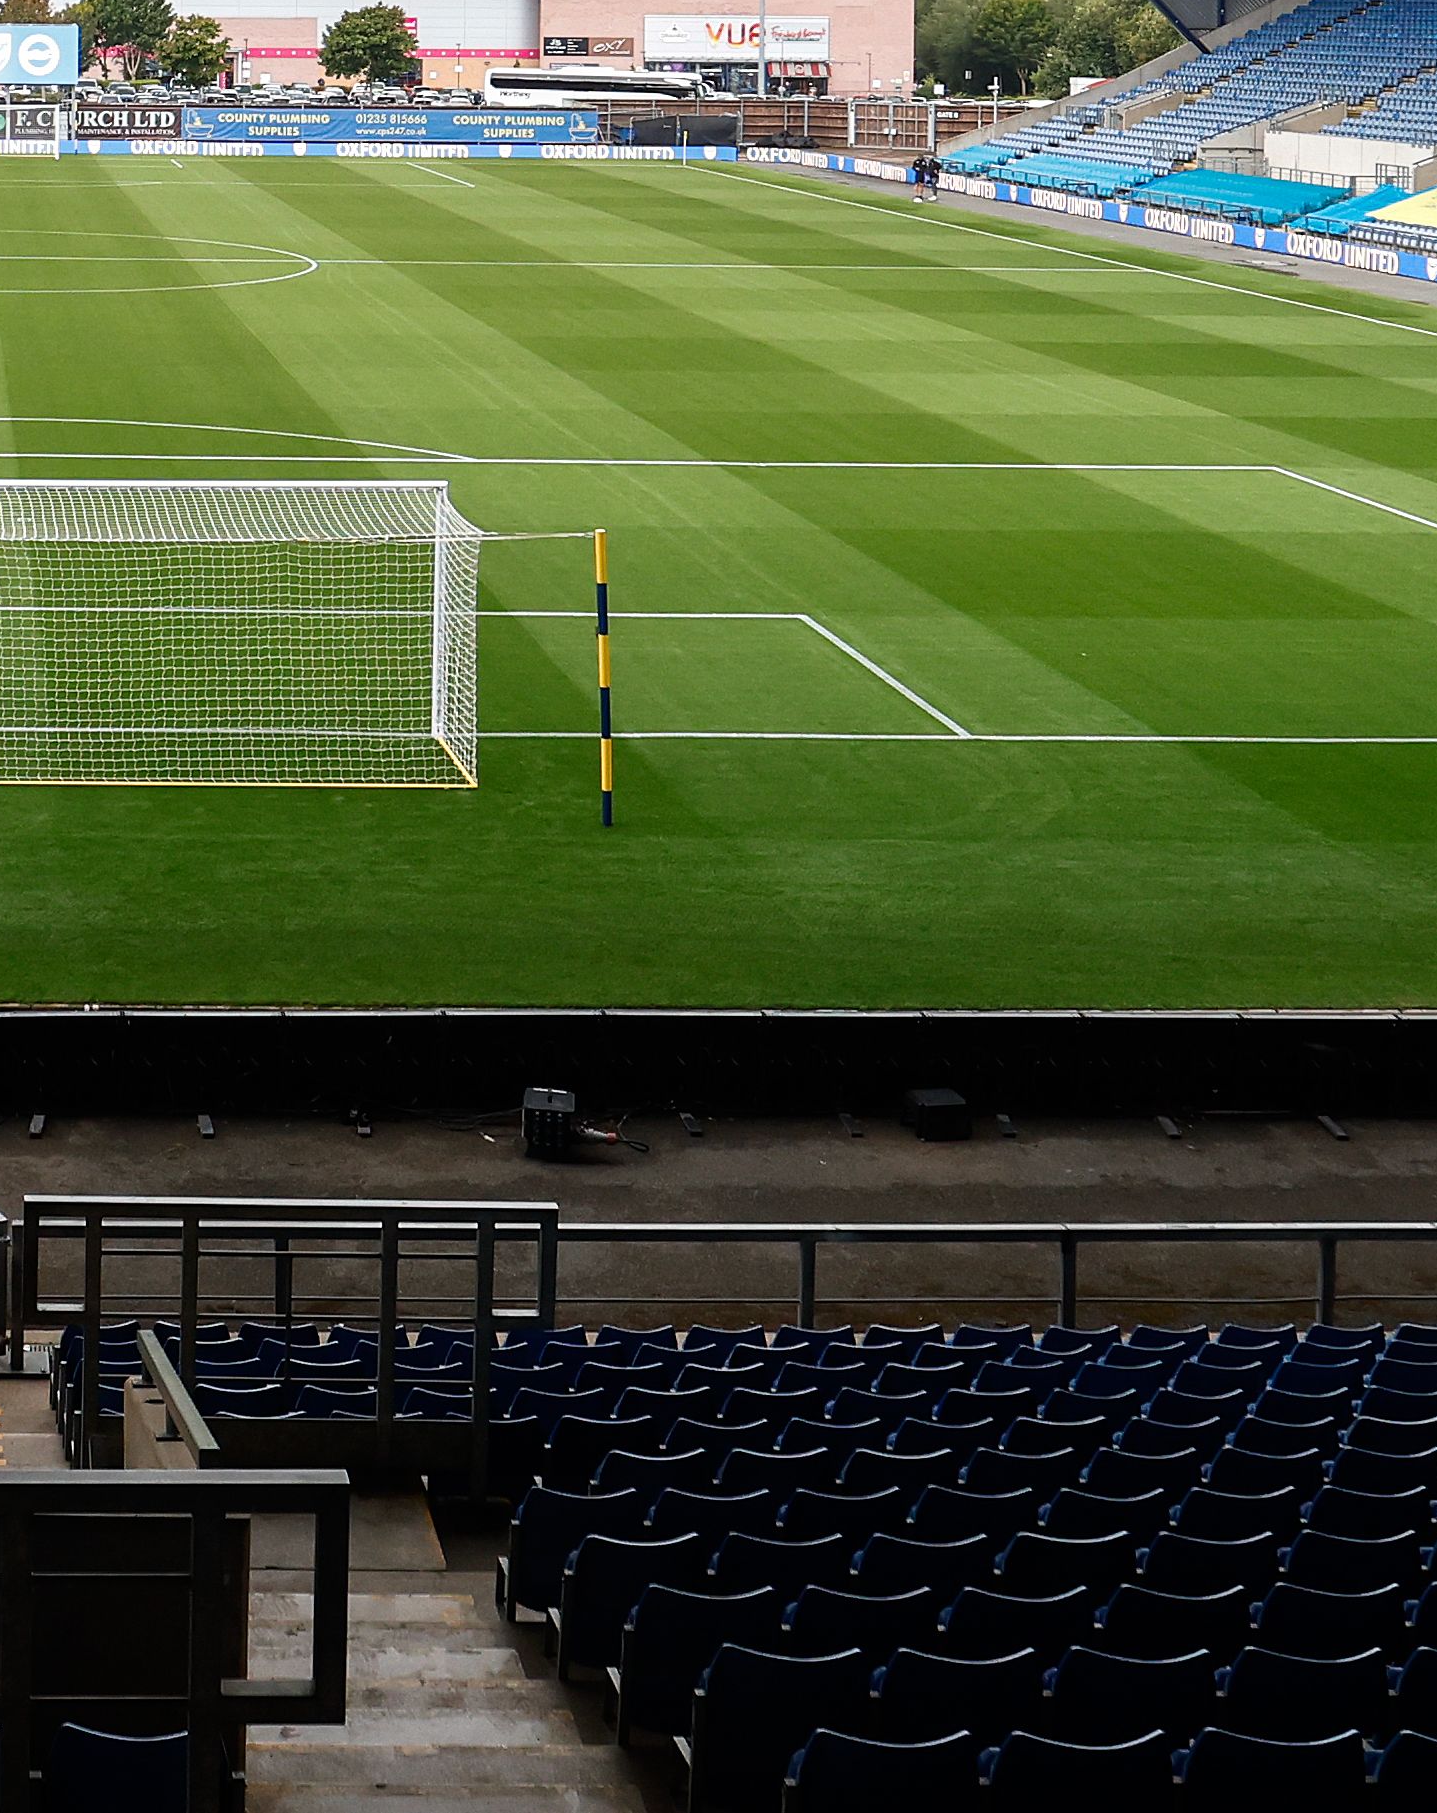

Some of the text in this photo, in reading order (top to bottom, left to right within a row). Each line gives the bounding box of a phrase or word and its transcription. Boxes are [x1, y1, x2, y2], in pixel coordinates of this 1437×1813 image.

[133, 111, 175, 128] LTD
[218, 113, 330, 124] COUNTY PLUMBING
[355, 114, 428, 124] 01235 815666
[453, 115, 565, 126] COUNTY PLUMBING
[248, 126, 300, 137] SUPPLIES
[483, 128, 535, 138] SUPPLIES
[131, 140, 199, 155] OXFORD
[336, 143, 404, 158] OXFORD
[540, 144, 610, 159] OXFORD
[746, 146, 828, 169] OXFORD UNITED
[854, 158, 907, 182] OXFORD UNITED
[966, 177, 996, 200] UNITED
[1030, 188, 1103, 219] OXFORD UNITED
[1144, 208, 1234, 245] OXFORD UNITED
[1286, 232, 1400, 275] OXFORD UNITED
